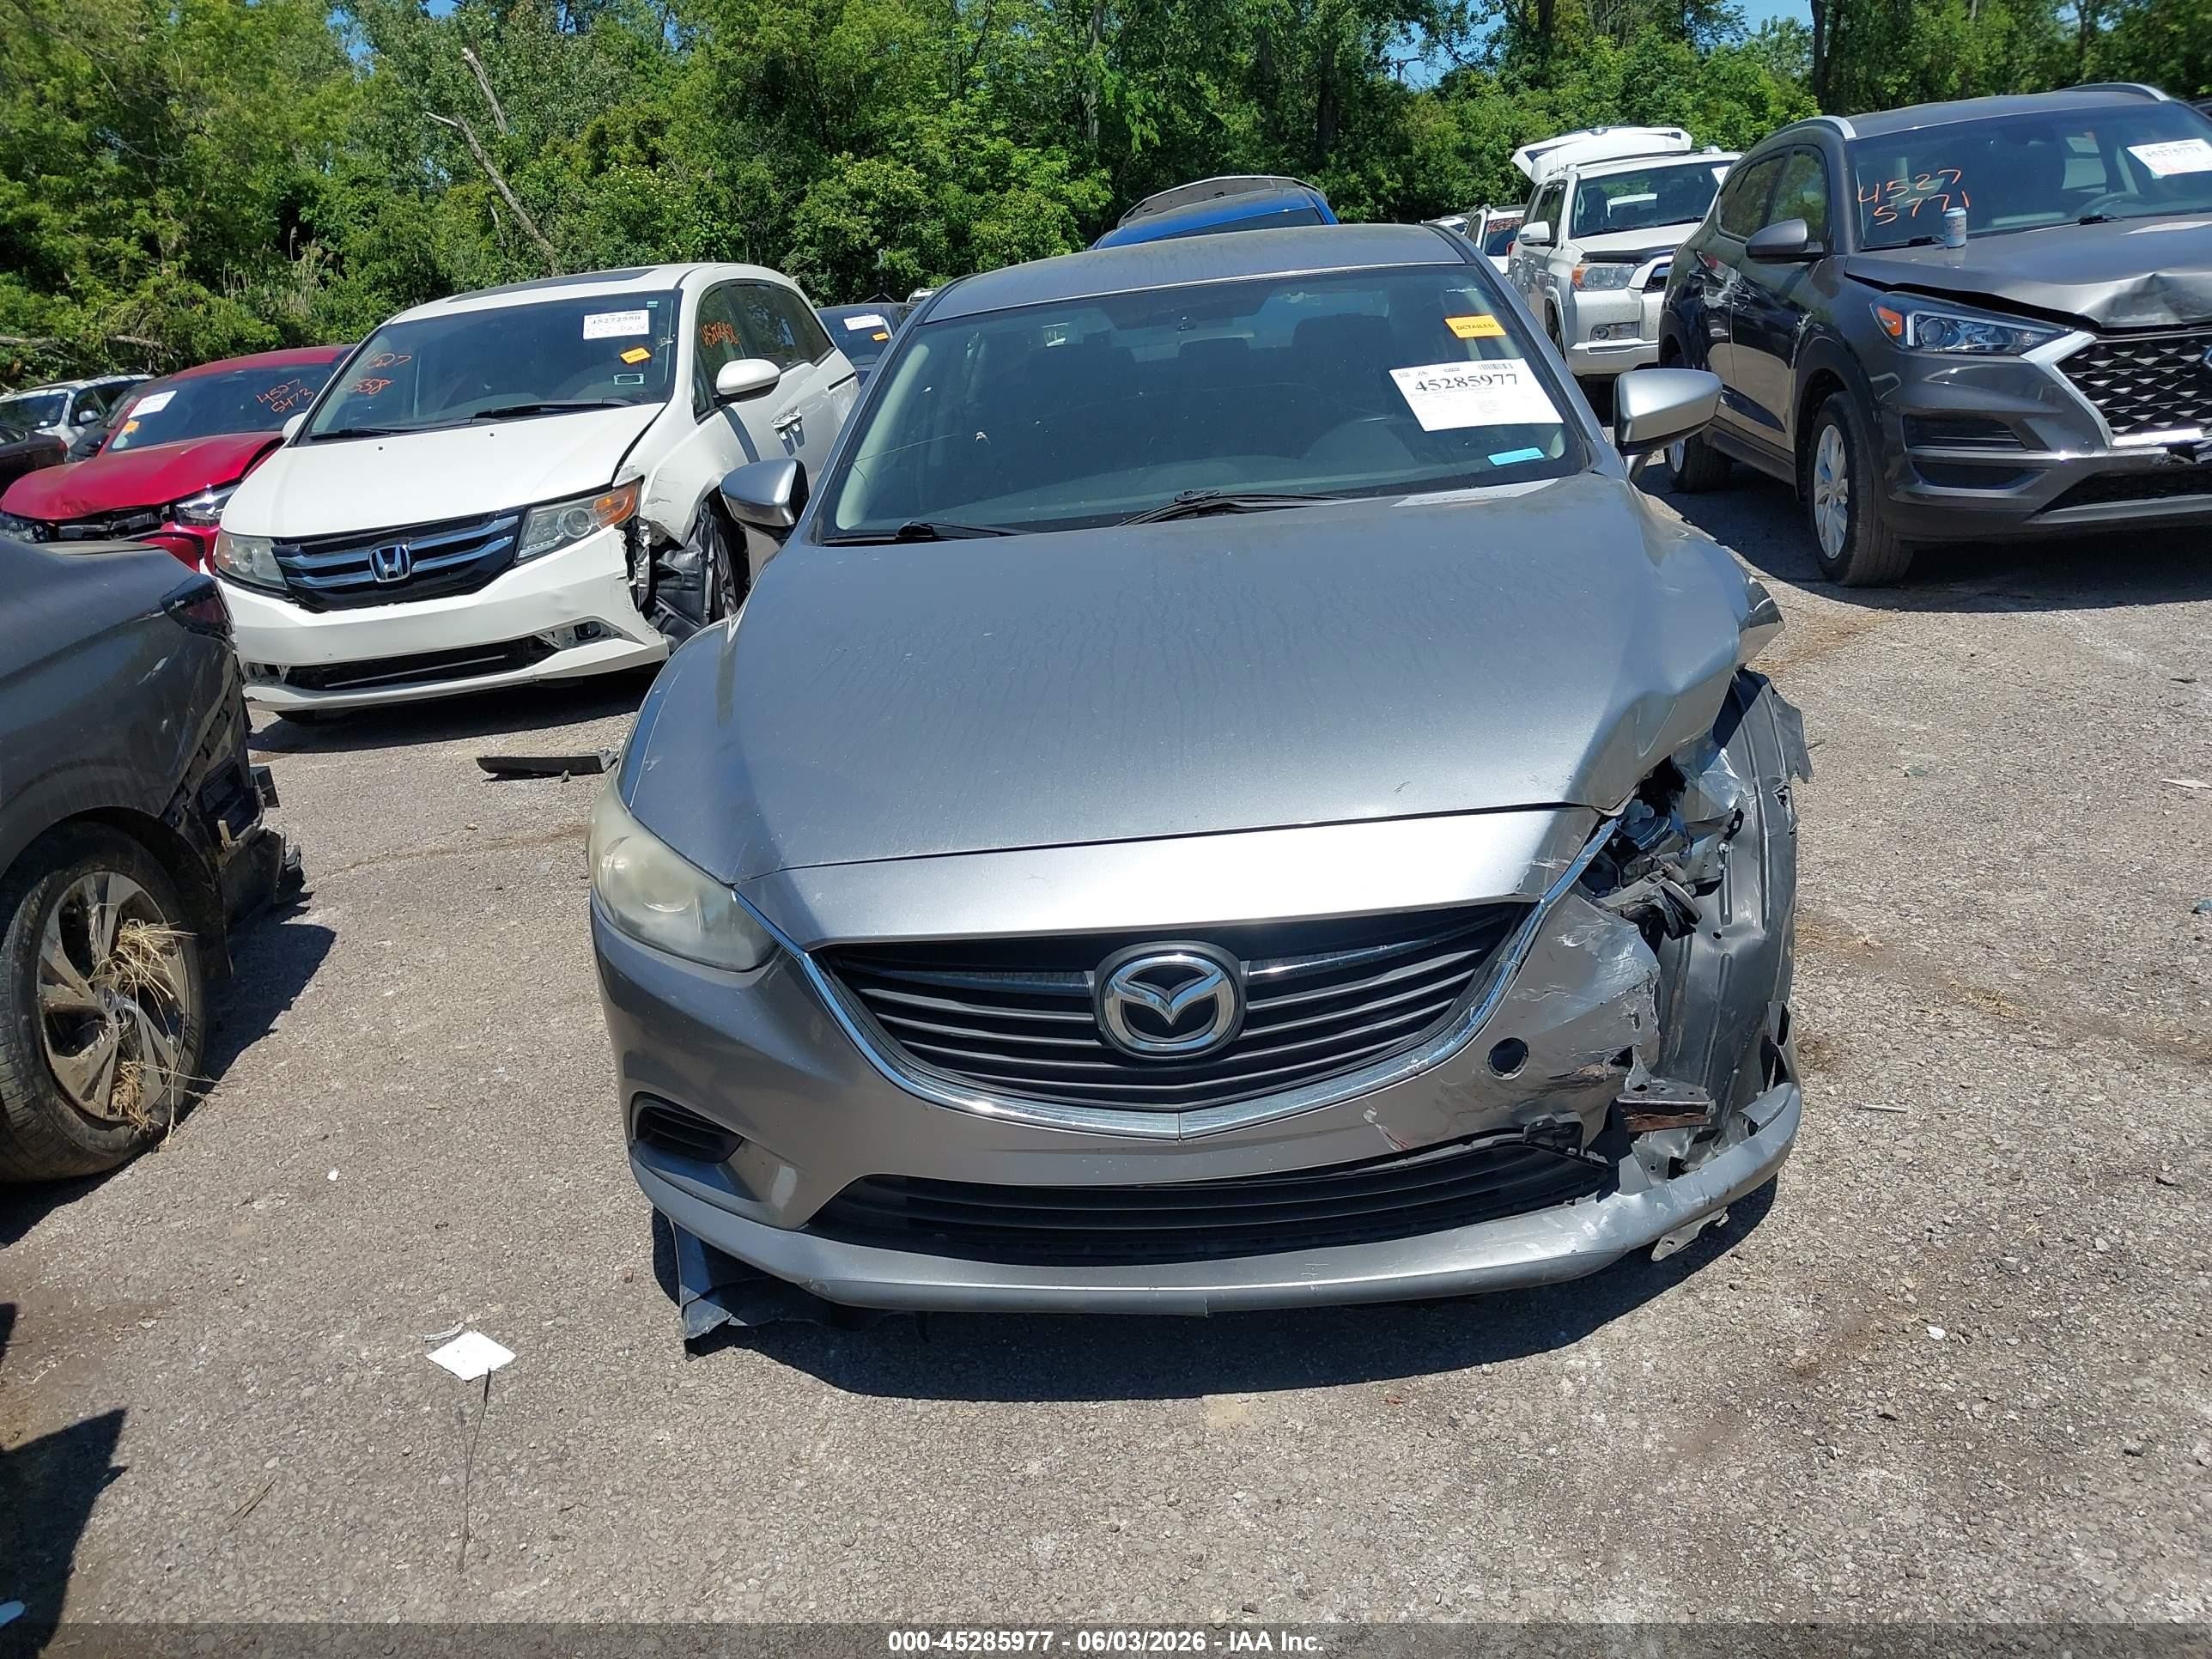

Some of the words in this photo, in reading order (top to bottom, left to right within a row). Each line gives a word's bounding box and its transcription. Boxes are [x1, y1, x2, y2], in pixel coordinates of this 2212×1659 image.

[1857, 169, 1961, 204] 4527
[1873, 190, 1969, 225] 5771
[256, 378, 301, 404] 4527
[1415, 374, 1517, 392] 45285977
[270, 387, 314, 413] 5473
